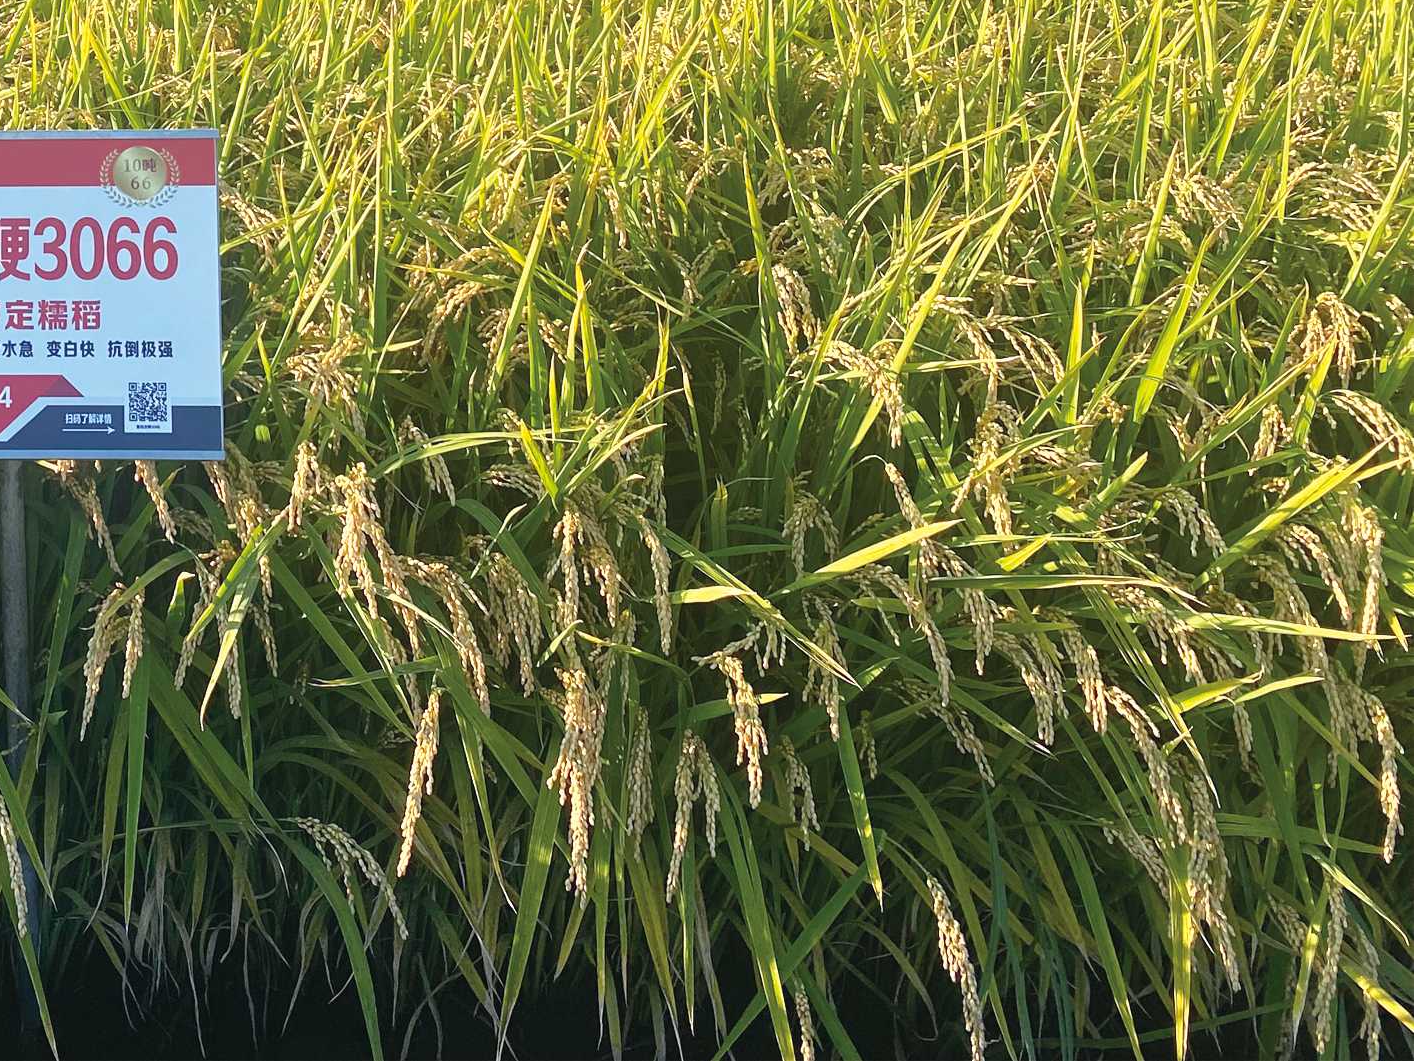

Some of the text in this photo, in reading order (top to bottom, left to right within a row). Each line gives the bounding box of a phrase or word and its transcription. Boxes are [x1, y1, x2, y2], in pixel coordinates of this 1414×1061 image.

[123, 158, 157, 172] 10吨
[131, 175, 151, 190] 66
[46, 340, 95, 358] 变白快
[107, 340, 174, 358] 抗倒极强
